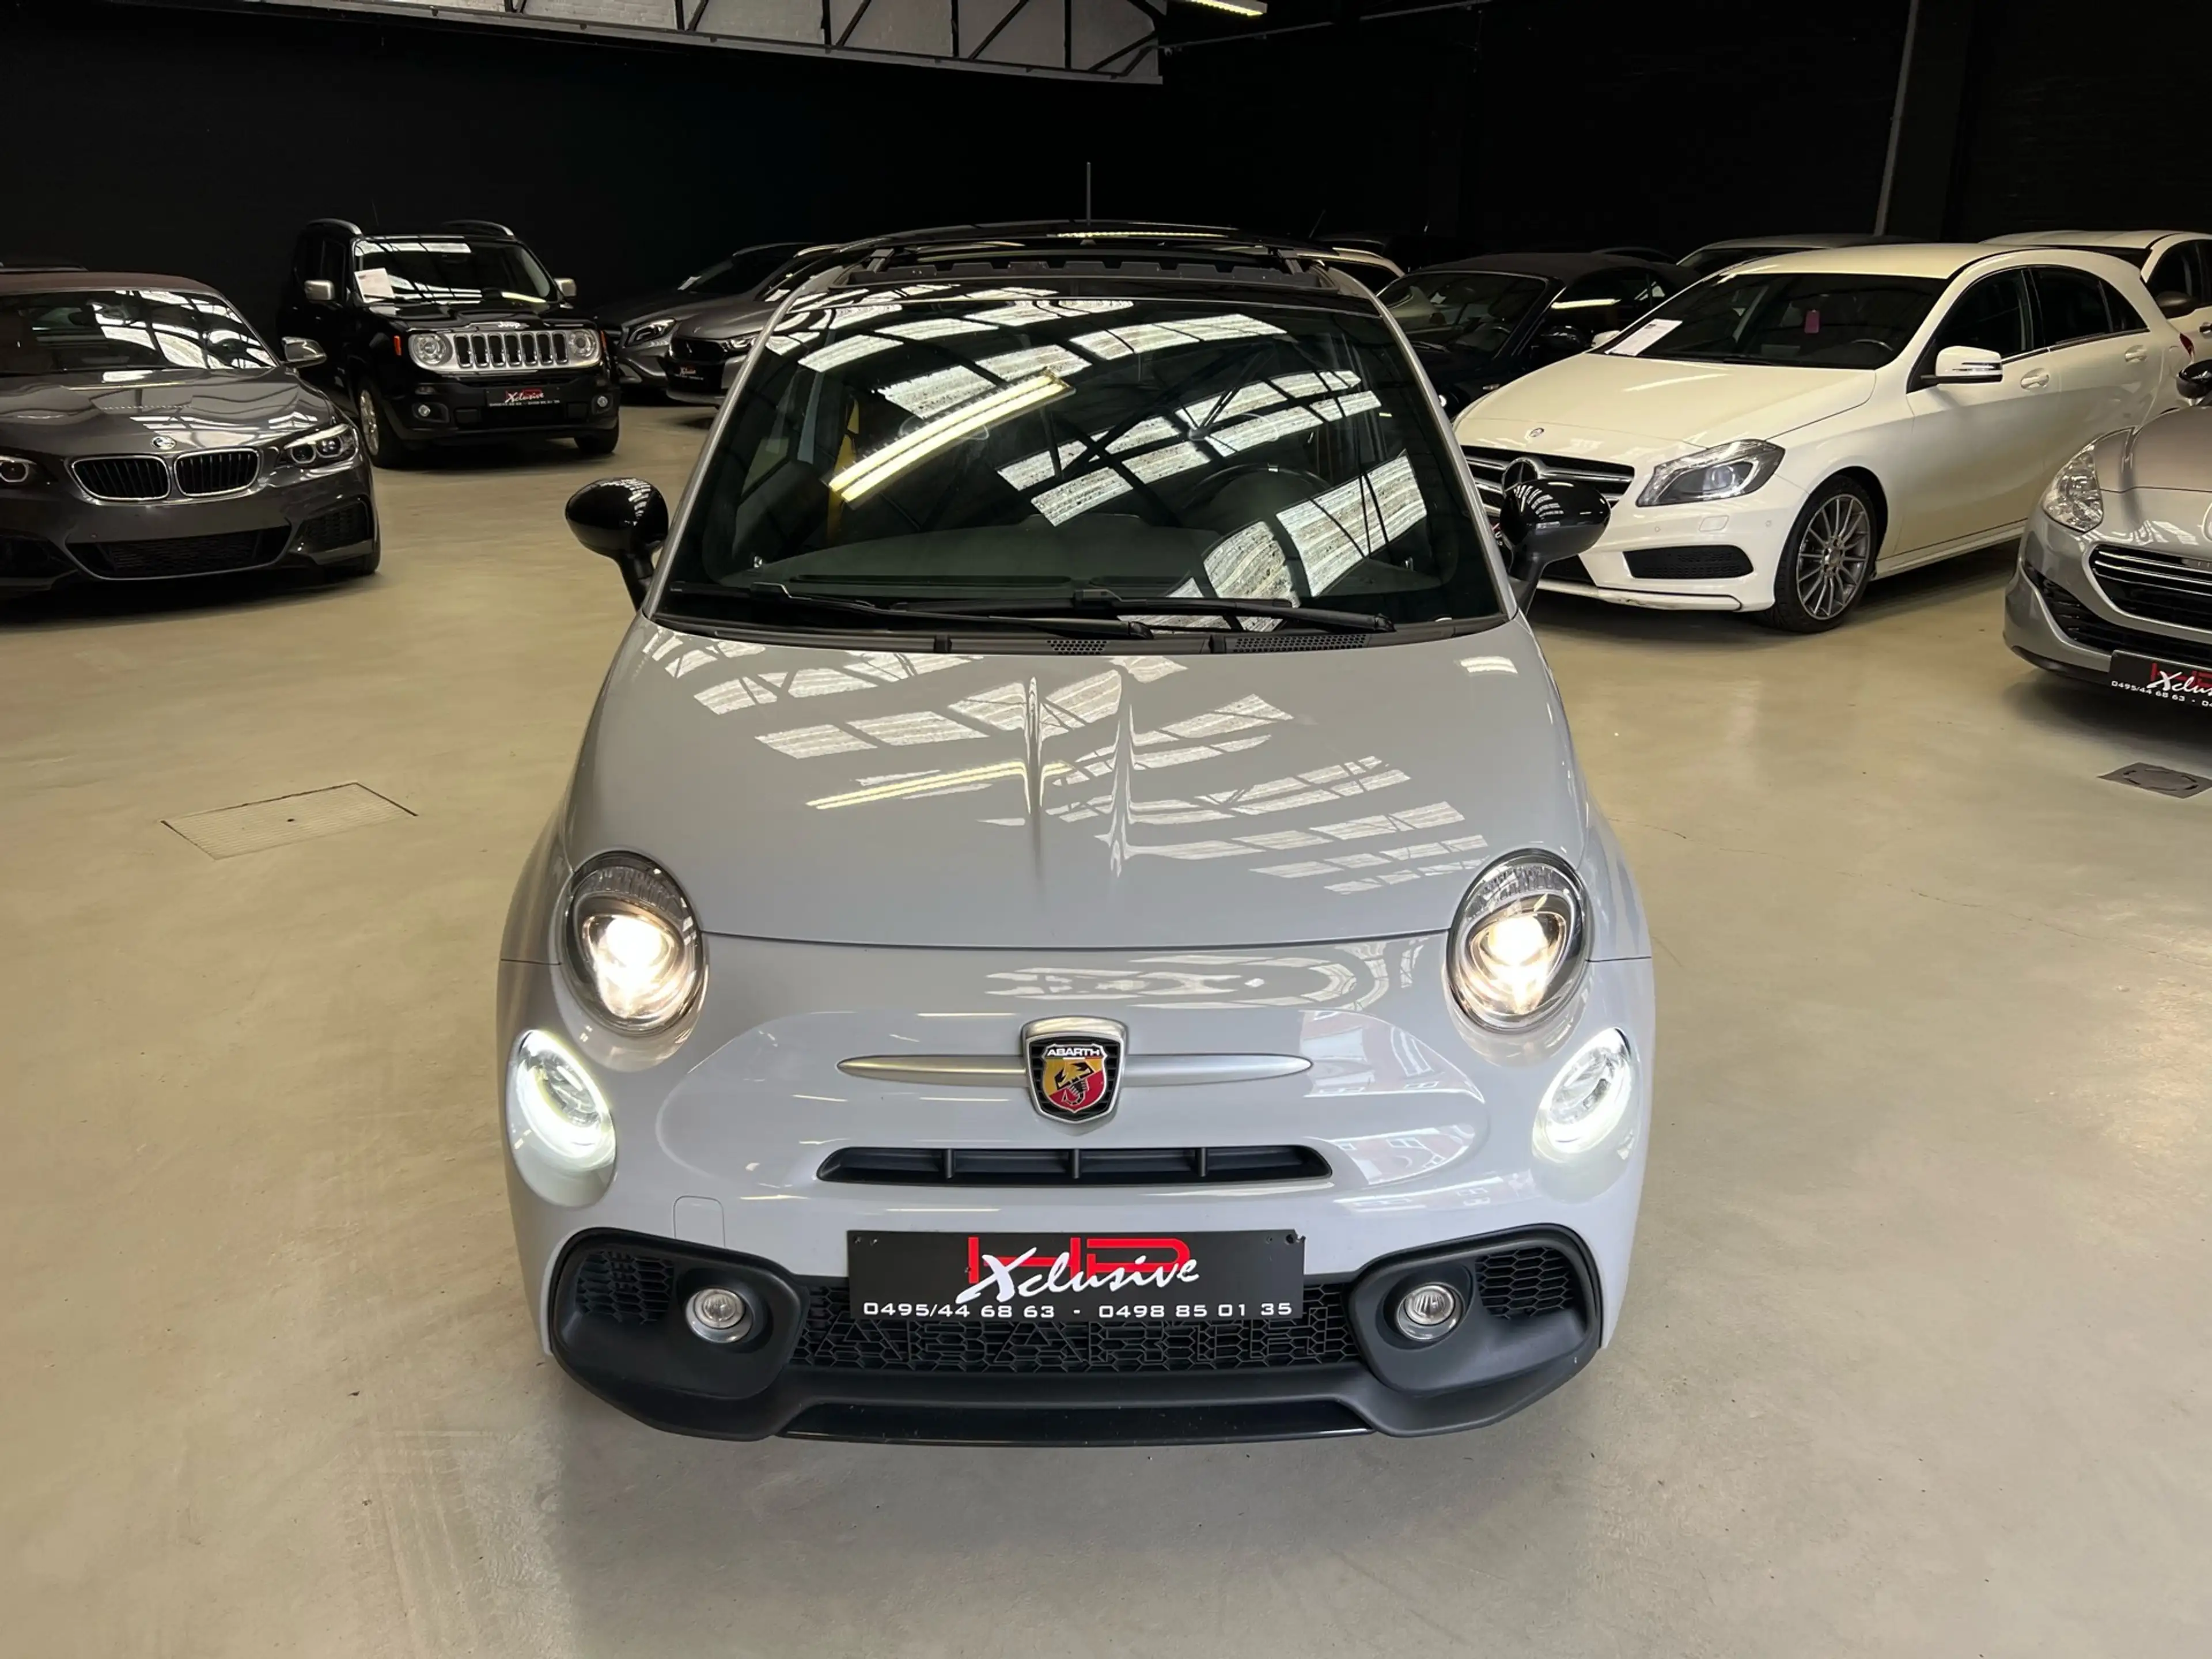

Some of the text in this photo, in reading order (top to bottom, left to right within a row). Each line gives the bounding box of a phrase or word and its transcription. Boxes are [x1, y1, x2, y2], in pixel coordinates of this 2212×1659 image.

[1047, 1047, 1100, 1056] ABARTH
[955, 1247, 1199, 1304] Xclusive
[863, 1302, 970, 1317] 0495/44
[980, 1305, 1012, 1318] 68
[1024, 1305, 1054, 1319] 63
[1099, 1305, 1165, 1318] 0498
[1176, 1305, 1207, 1317] 85
[1218, 1304, 1245, 1317] 01
[1260, 1302, 1292, 1316] 35
